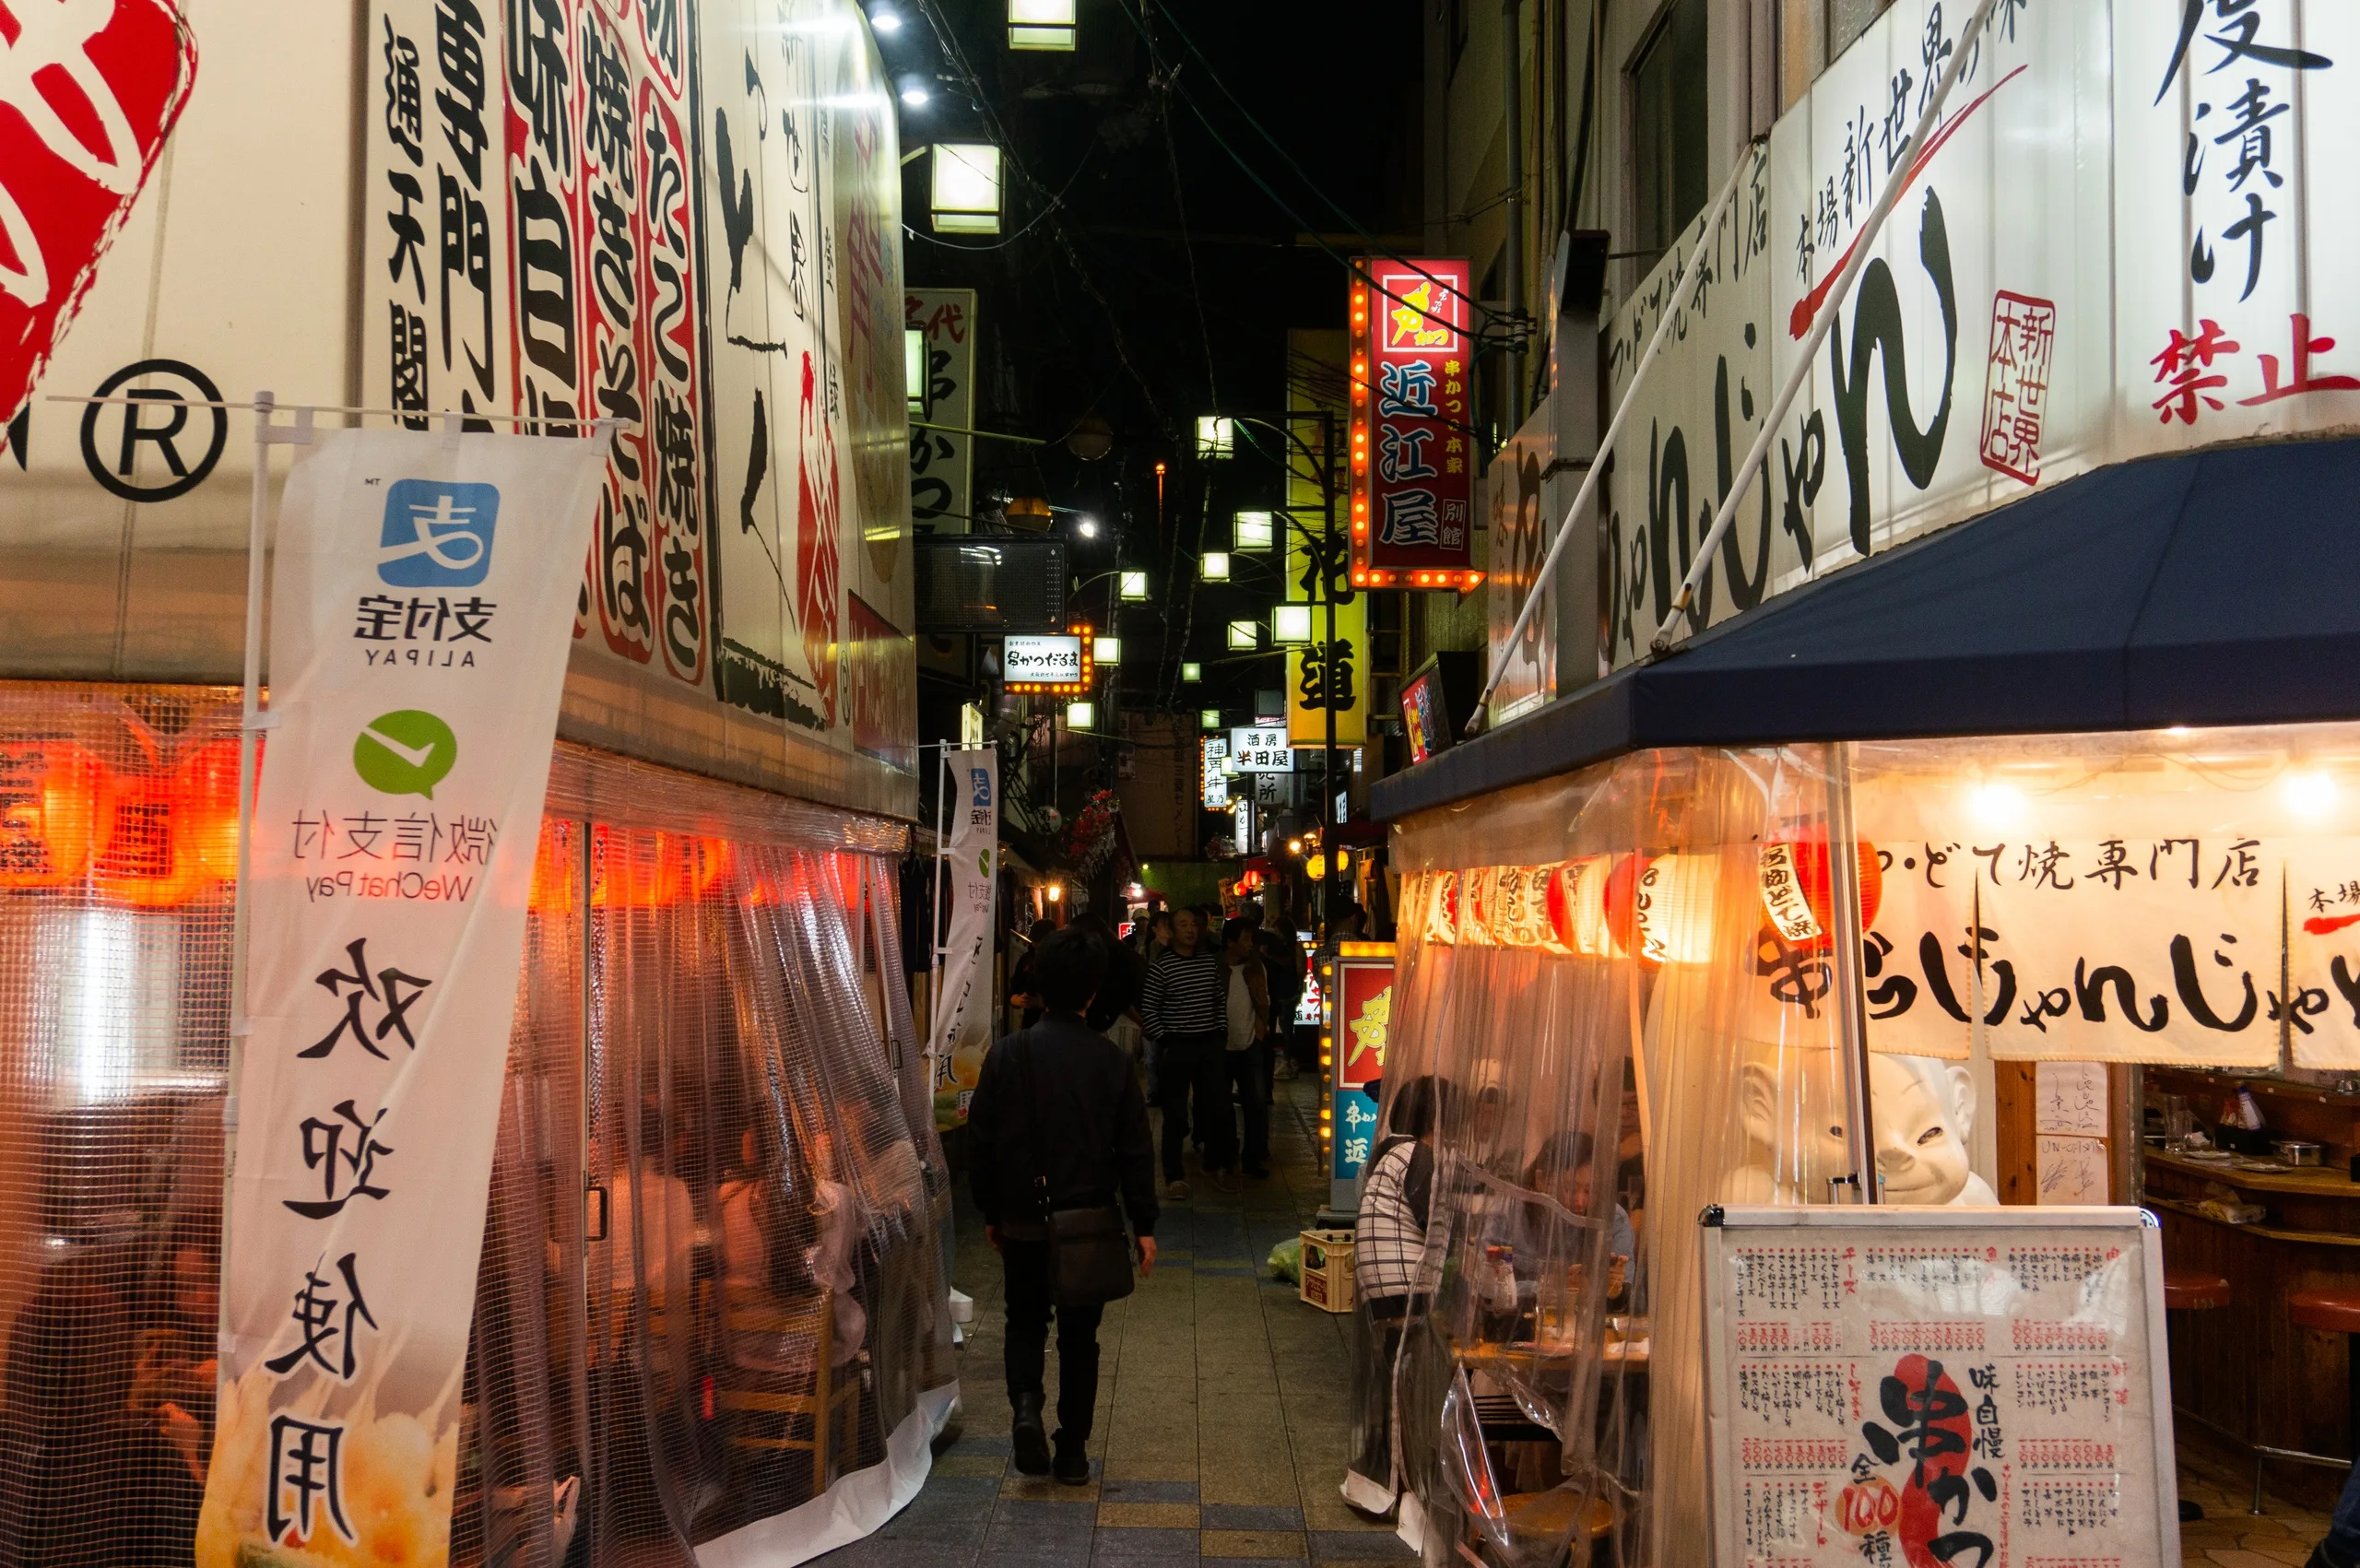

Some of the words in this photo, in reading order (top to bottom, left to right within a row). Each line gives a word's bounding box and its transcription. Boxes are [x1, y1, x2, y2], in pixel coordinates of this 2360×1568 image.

[2150, 313, 2360, 426] 禁止
[1379, 360, 1438, 547] 近江屋
[1444, 501, 1464, 547] 別館
[1007, 649, 1079, 669] 串かつだるま
[1247, 733, 1278, 747] 酒房
[1236, 749, 1290, 767] 半田屋
